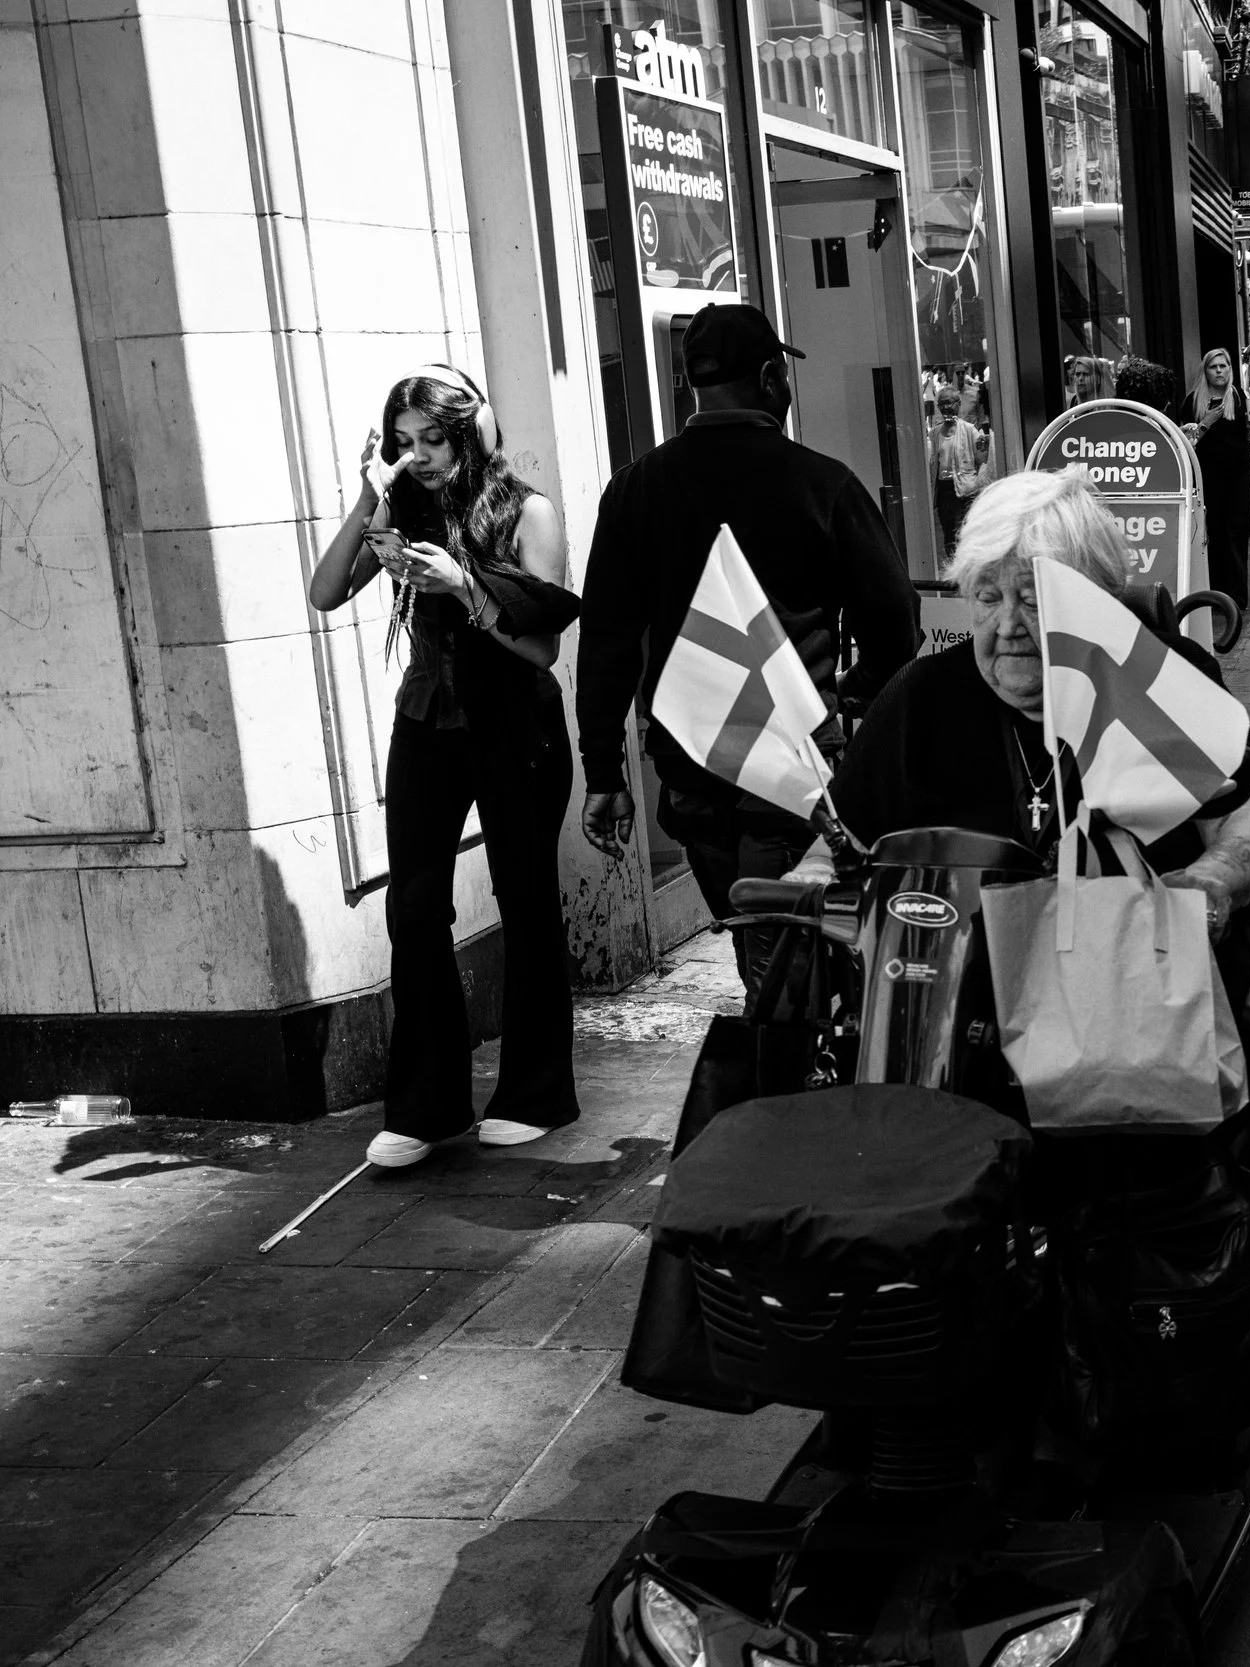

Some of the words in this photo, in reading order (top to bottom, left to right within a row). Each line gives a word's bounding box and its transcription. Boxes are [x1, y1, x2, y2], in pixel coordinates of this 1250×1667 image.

[632, 19, 706, 101] atm
[815, 86, 827, 115] 12
[627, 113, 664, 152] Free
[667, 129, 704, 160] cash
[632, 158, 724, 202] withdrawals
[1062, 436, 1157, 462] Change
[931, 628, 972, 644] West
[894, 902, 946, 914] INVACARE
